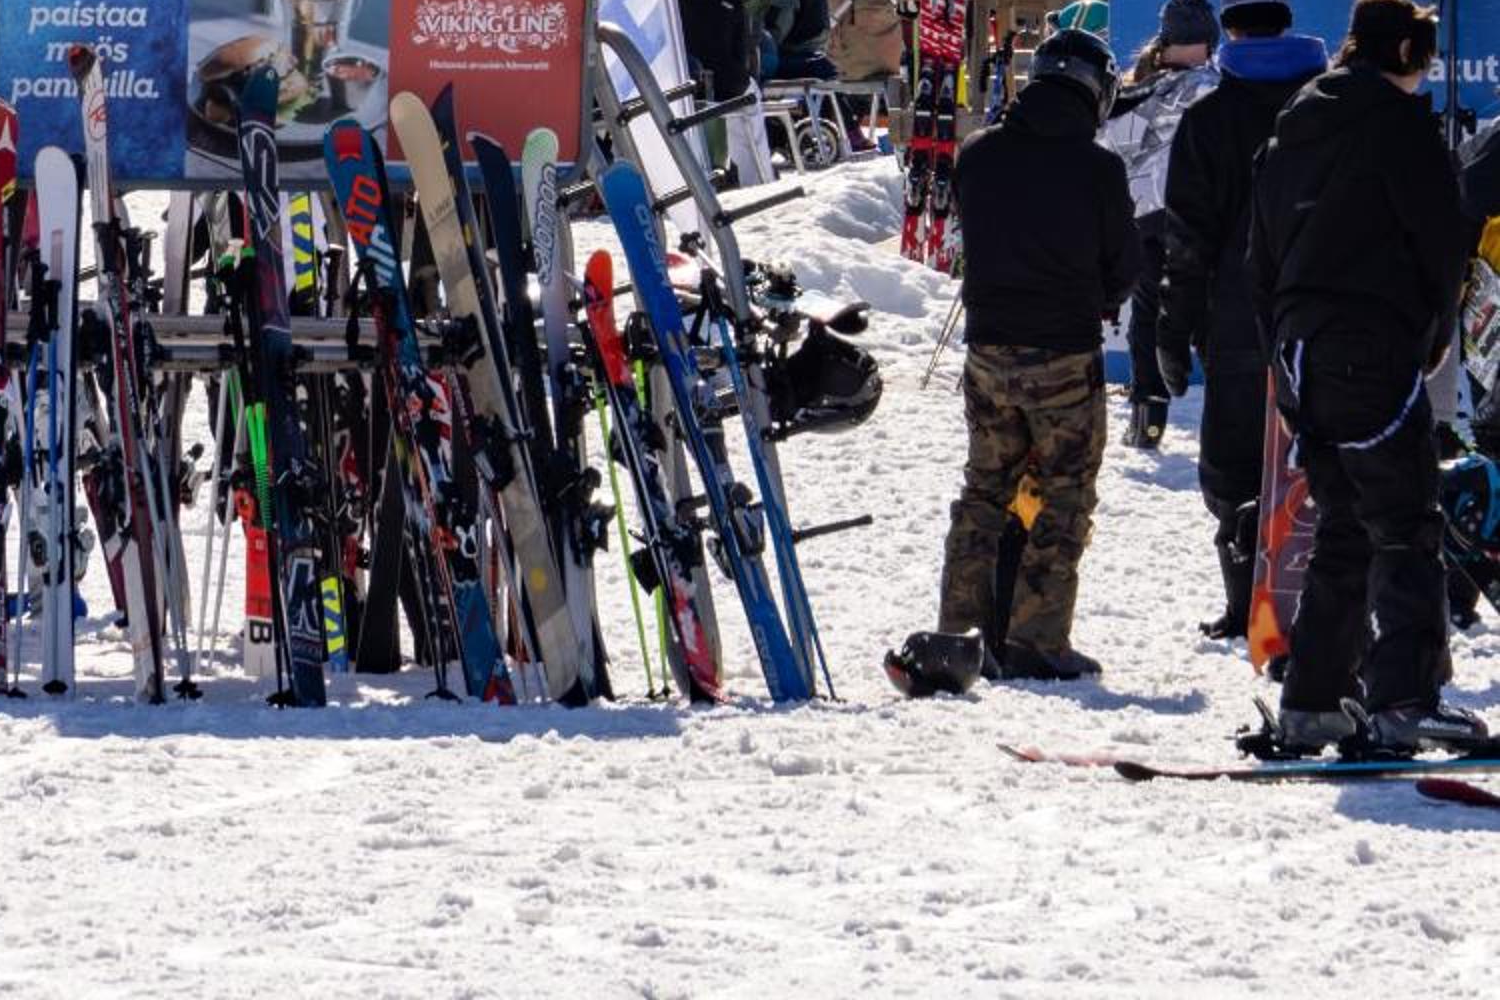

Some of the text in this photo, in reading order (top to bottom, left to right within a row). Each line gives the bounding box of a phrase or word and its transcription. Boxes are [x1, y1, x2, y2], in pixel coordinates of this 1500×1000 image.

[27, 0, 148, 35] paistaa
[423, 14, 558, 34] VIKING LINE
[45, 36, 130, 63] mös
[1426, 54, 1499, 83] aut
